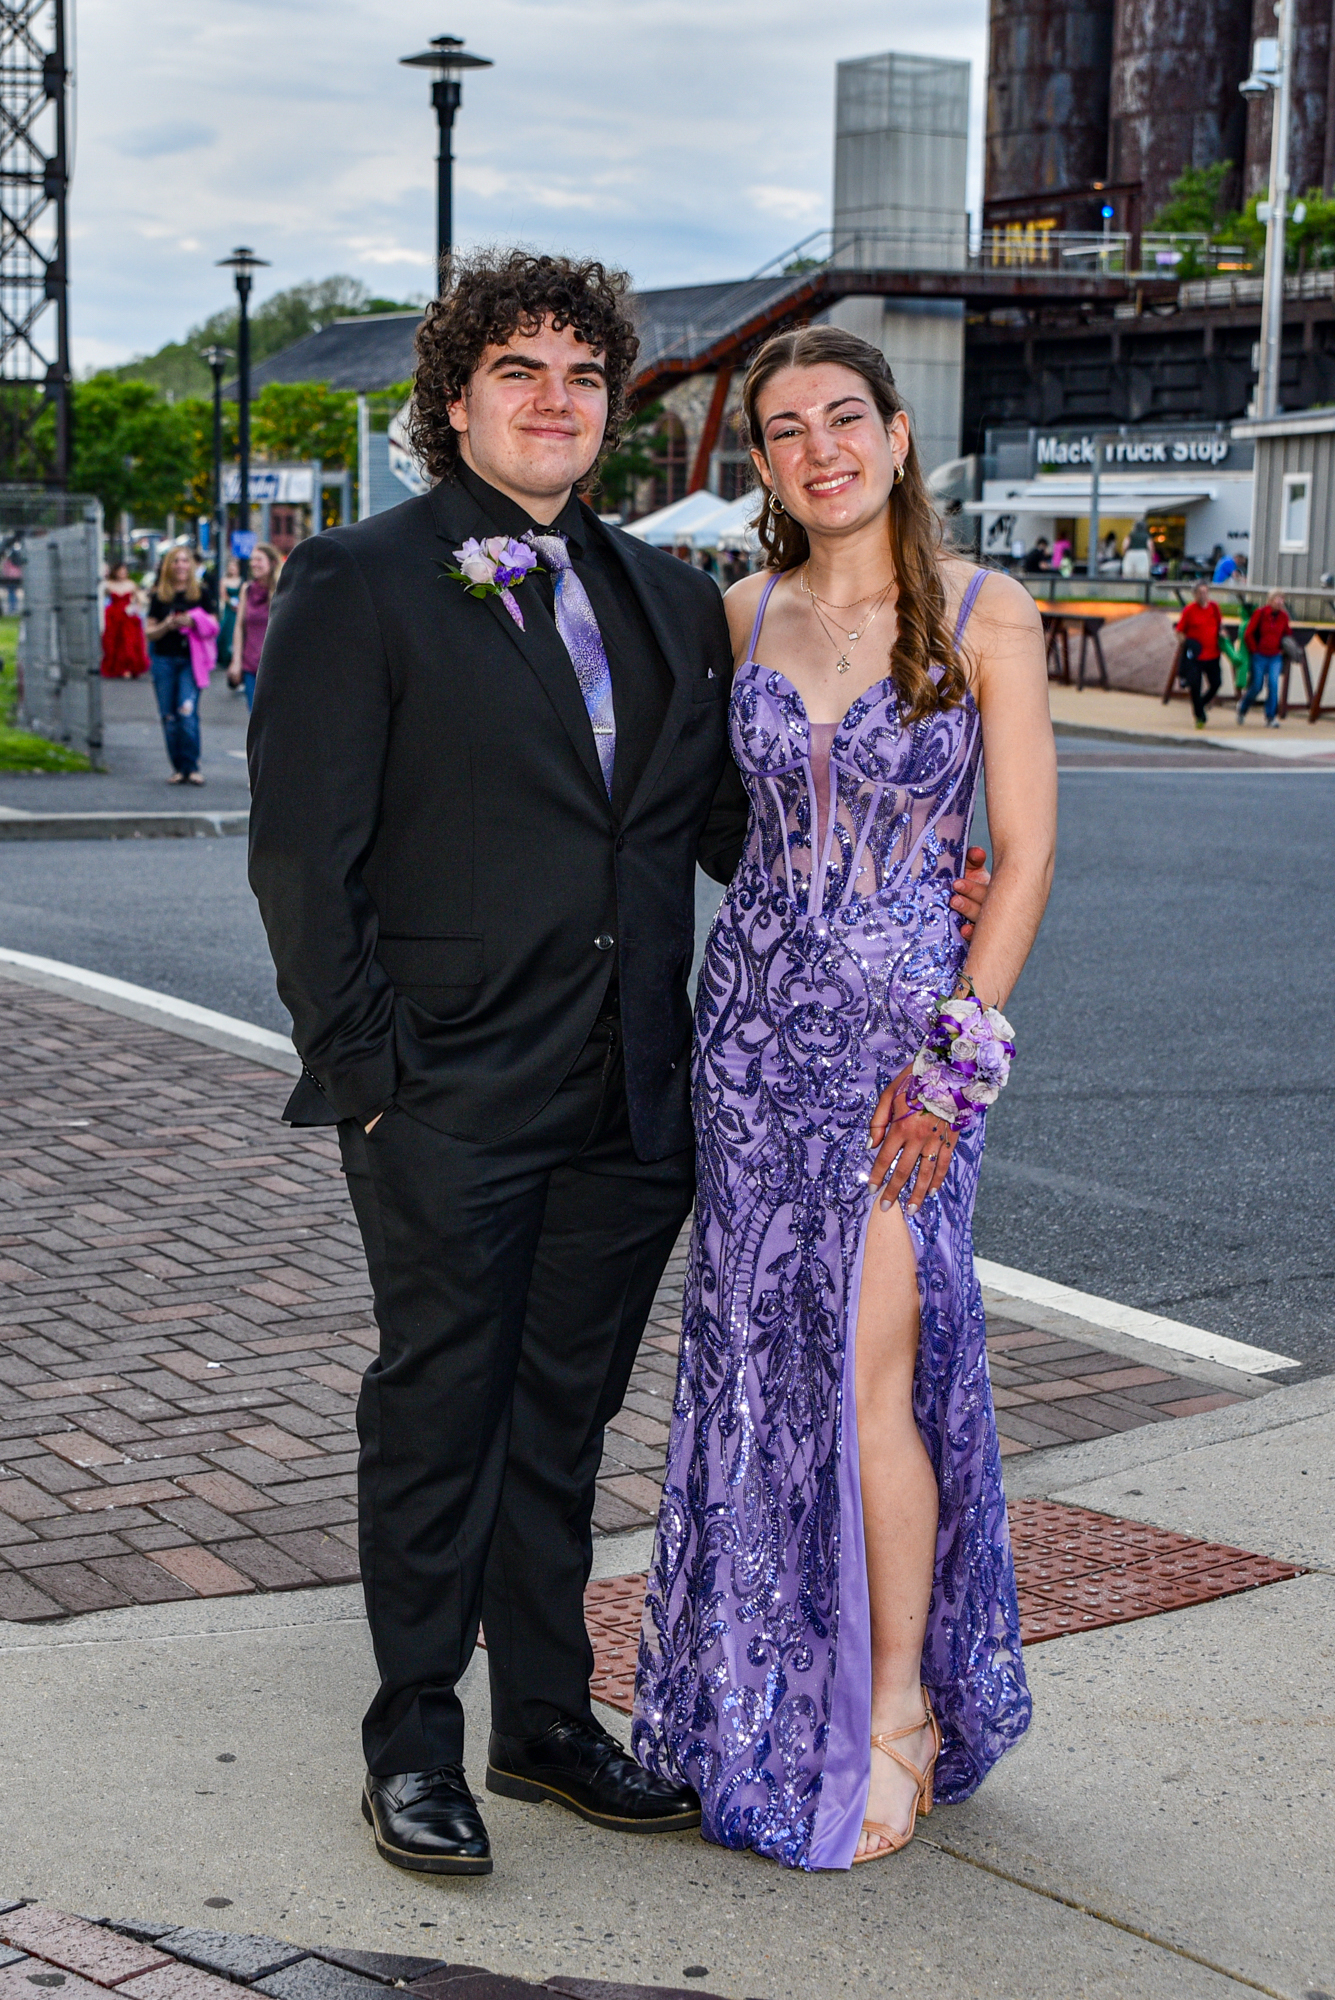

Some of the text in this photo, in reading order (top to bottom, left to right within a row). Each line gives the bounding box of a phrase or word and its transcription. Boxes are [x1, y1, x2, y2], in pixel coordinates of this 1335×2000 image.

[1037, 436, 1228, 465] Mack Truck Stop
